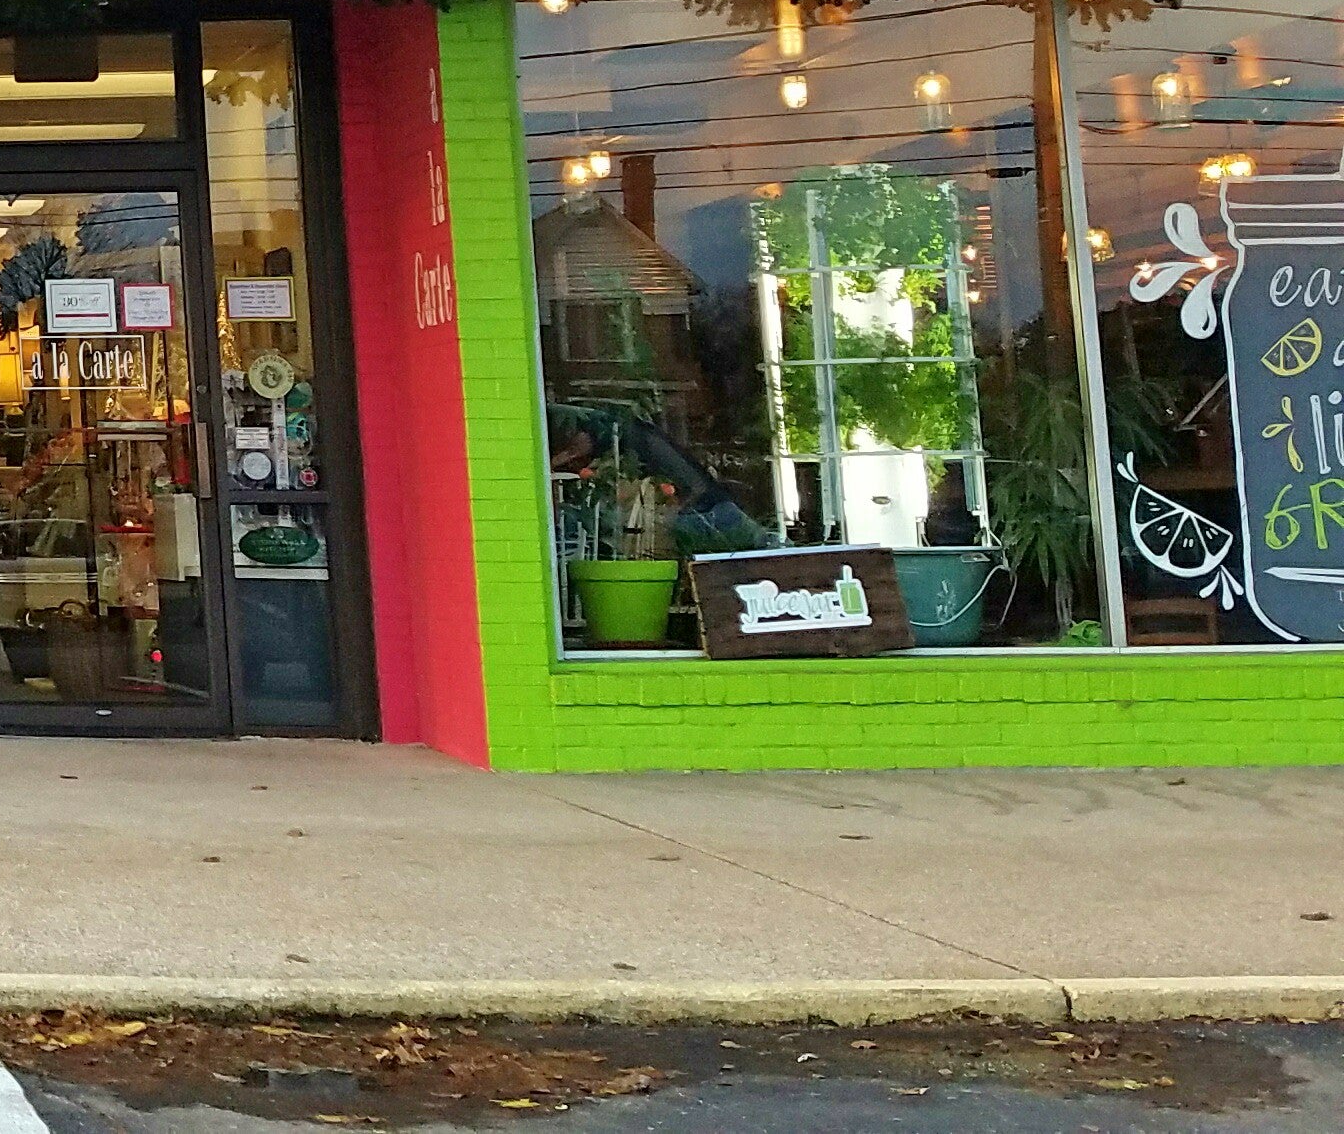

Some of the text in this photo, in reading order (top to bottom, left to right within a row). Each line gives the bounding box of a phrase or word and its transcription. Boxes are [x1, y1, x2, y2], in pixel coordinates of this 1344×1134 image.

[426, 150, 445, 227] la
[414, 251, 453, 330] Carte
[32, 340, 134, 381] a la Carte
